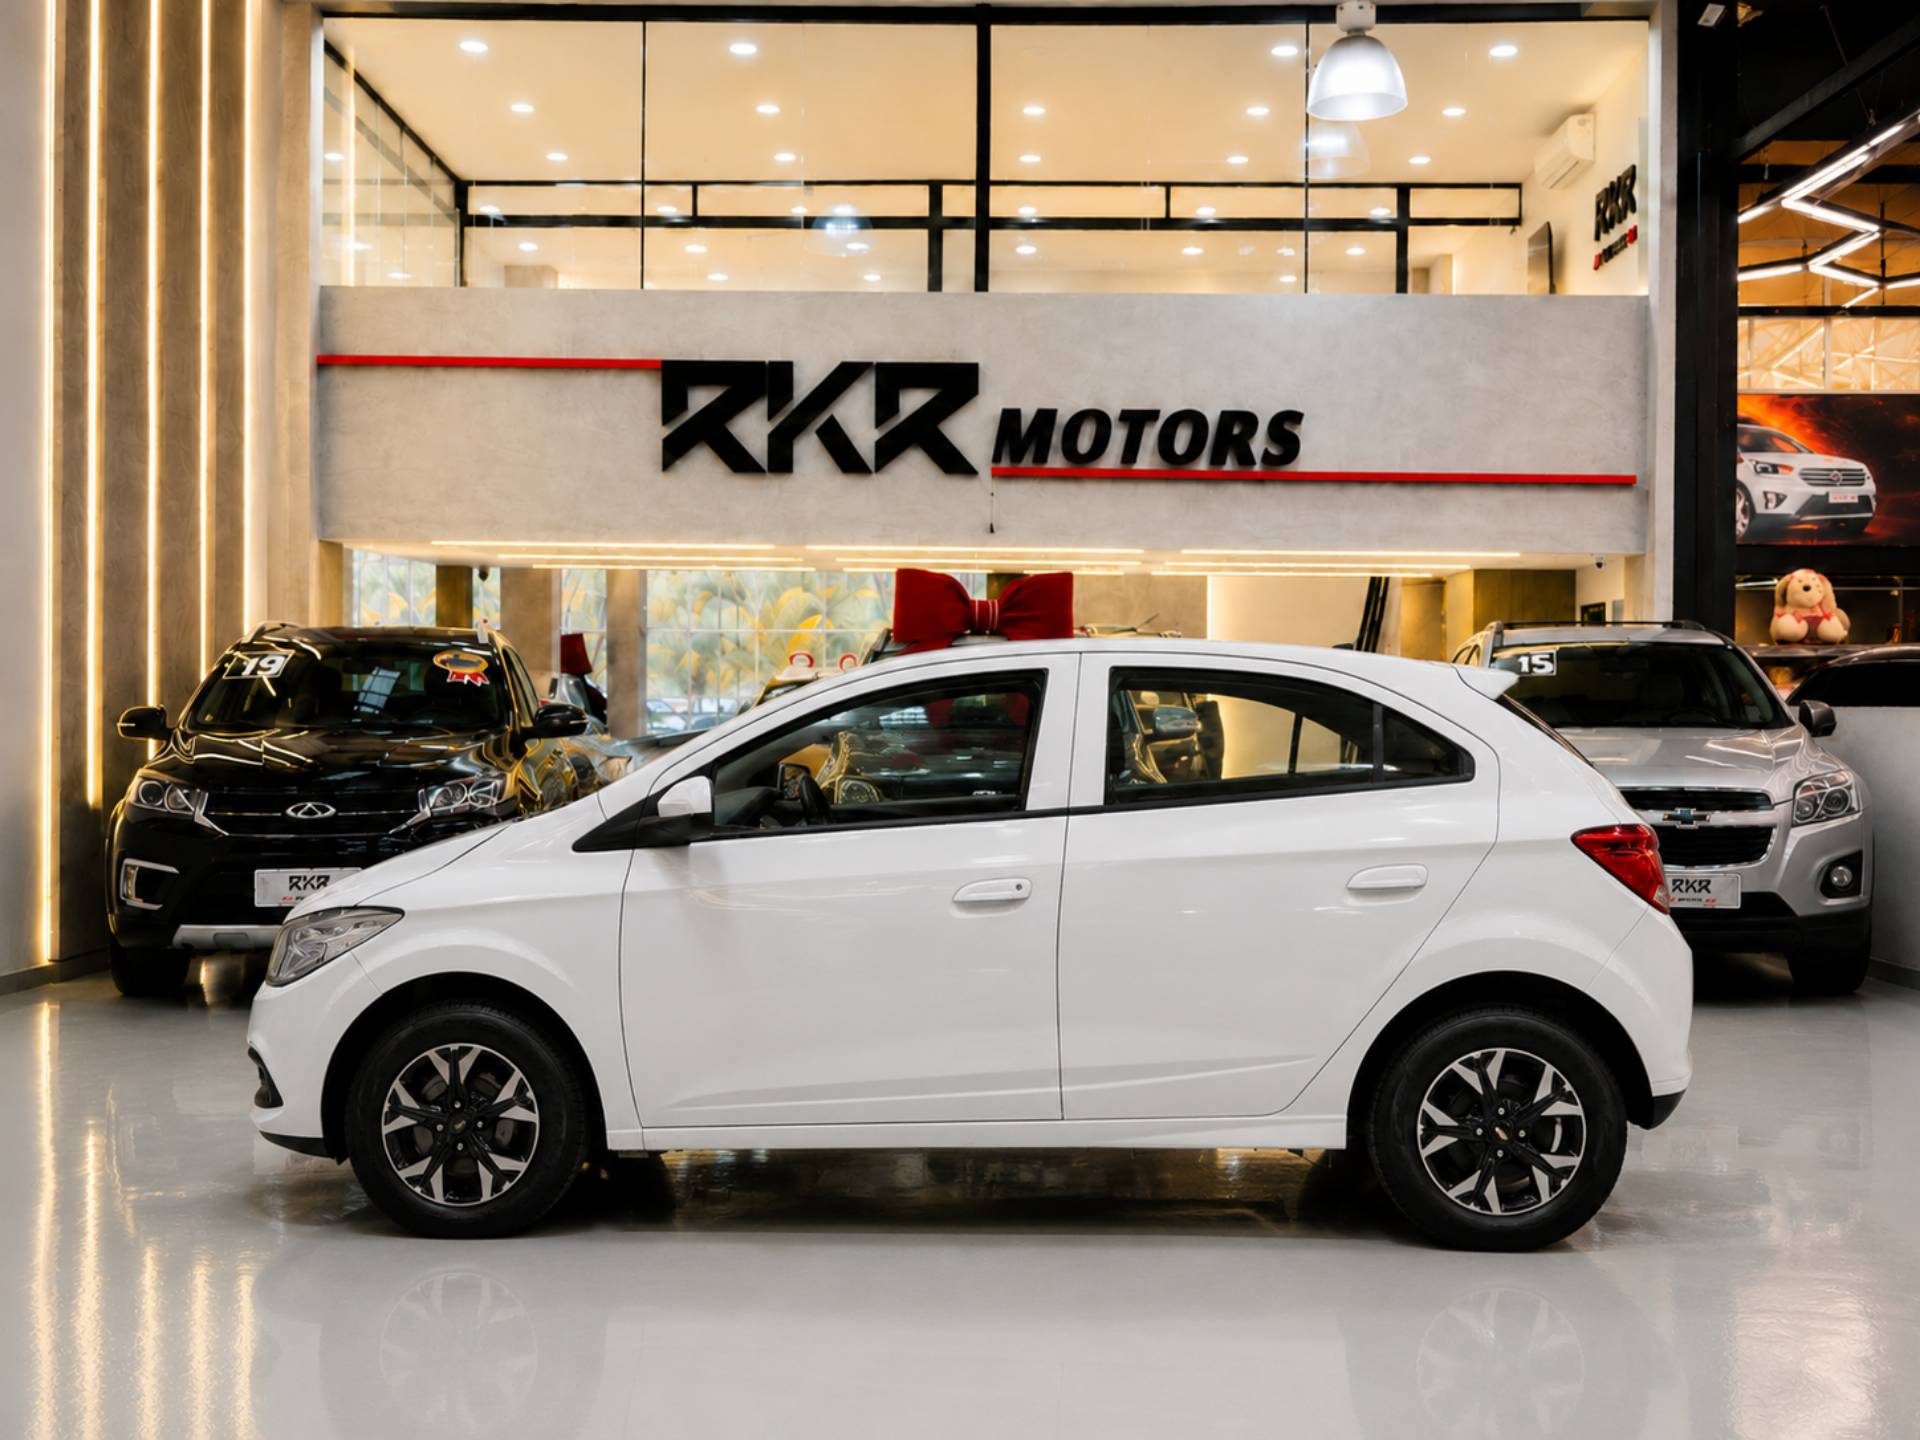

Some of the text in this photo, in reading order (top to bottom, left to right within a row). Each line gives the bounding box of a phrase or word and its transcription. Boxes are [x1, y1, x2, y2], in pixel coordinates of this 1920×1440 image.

[1594, 163, 1637, 241] RKR
[661, 360, 1304, 474] RKR MOTORS
[241, 654, 286, 676] 19
[1518, 654, 1554, 674] 15
[289, 874, 330, 891] RKR
[1671, 878, 1711, 894] RKR
